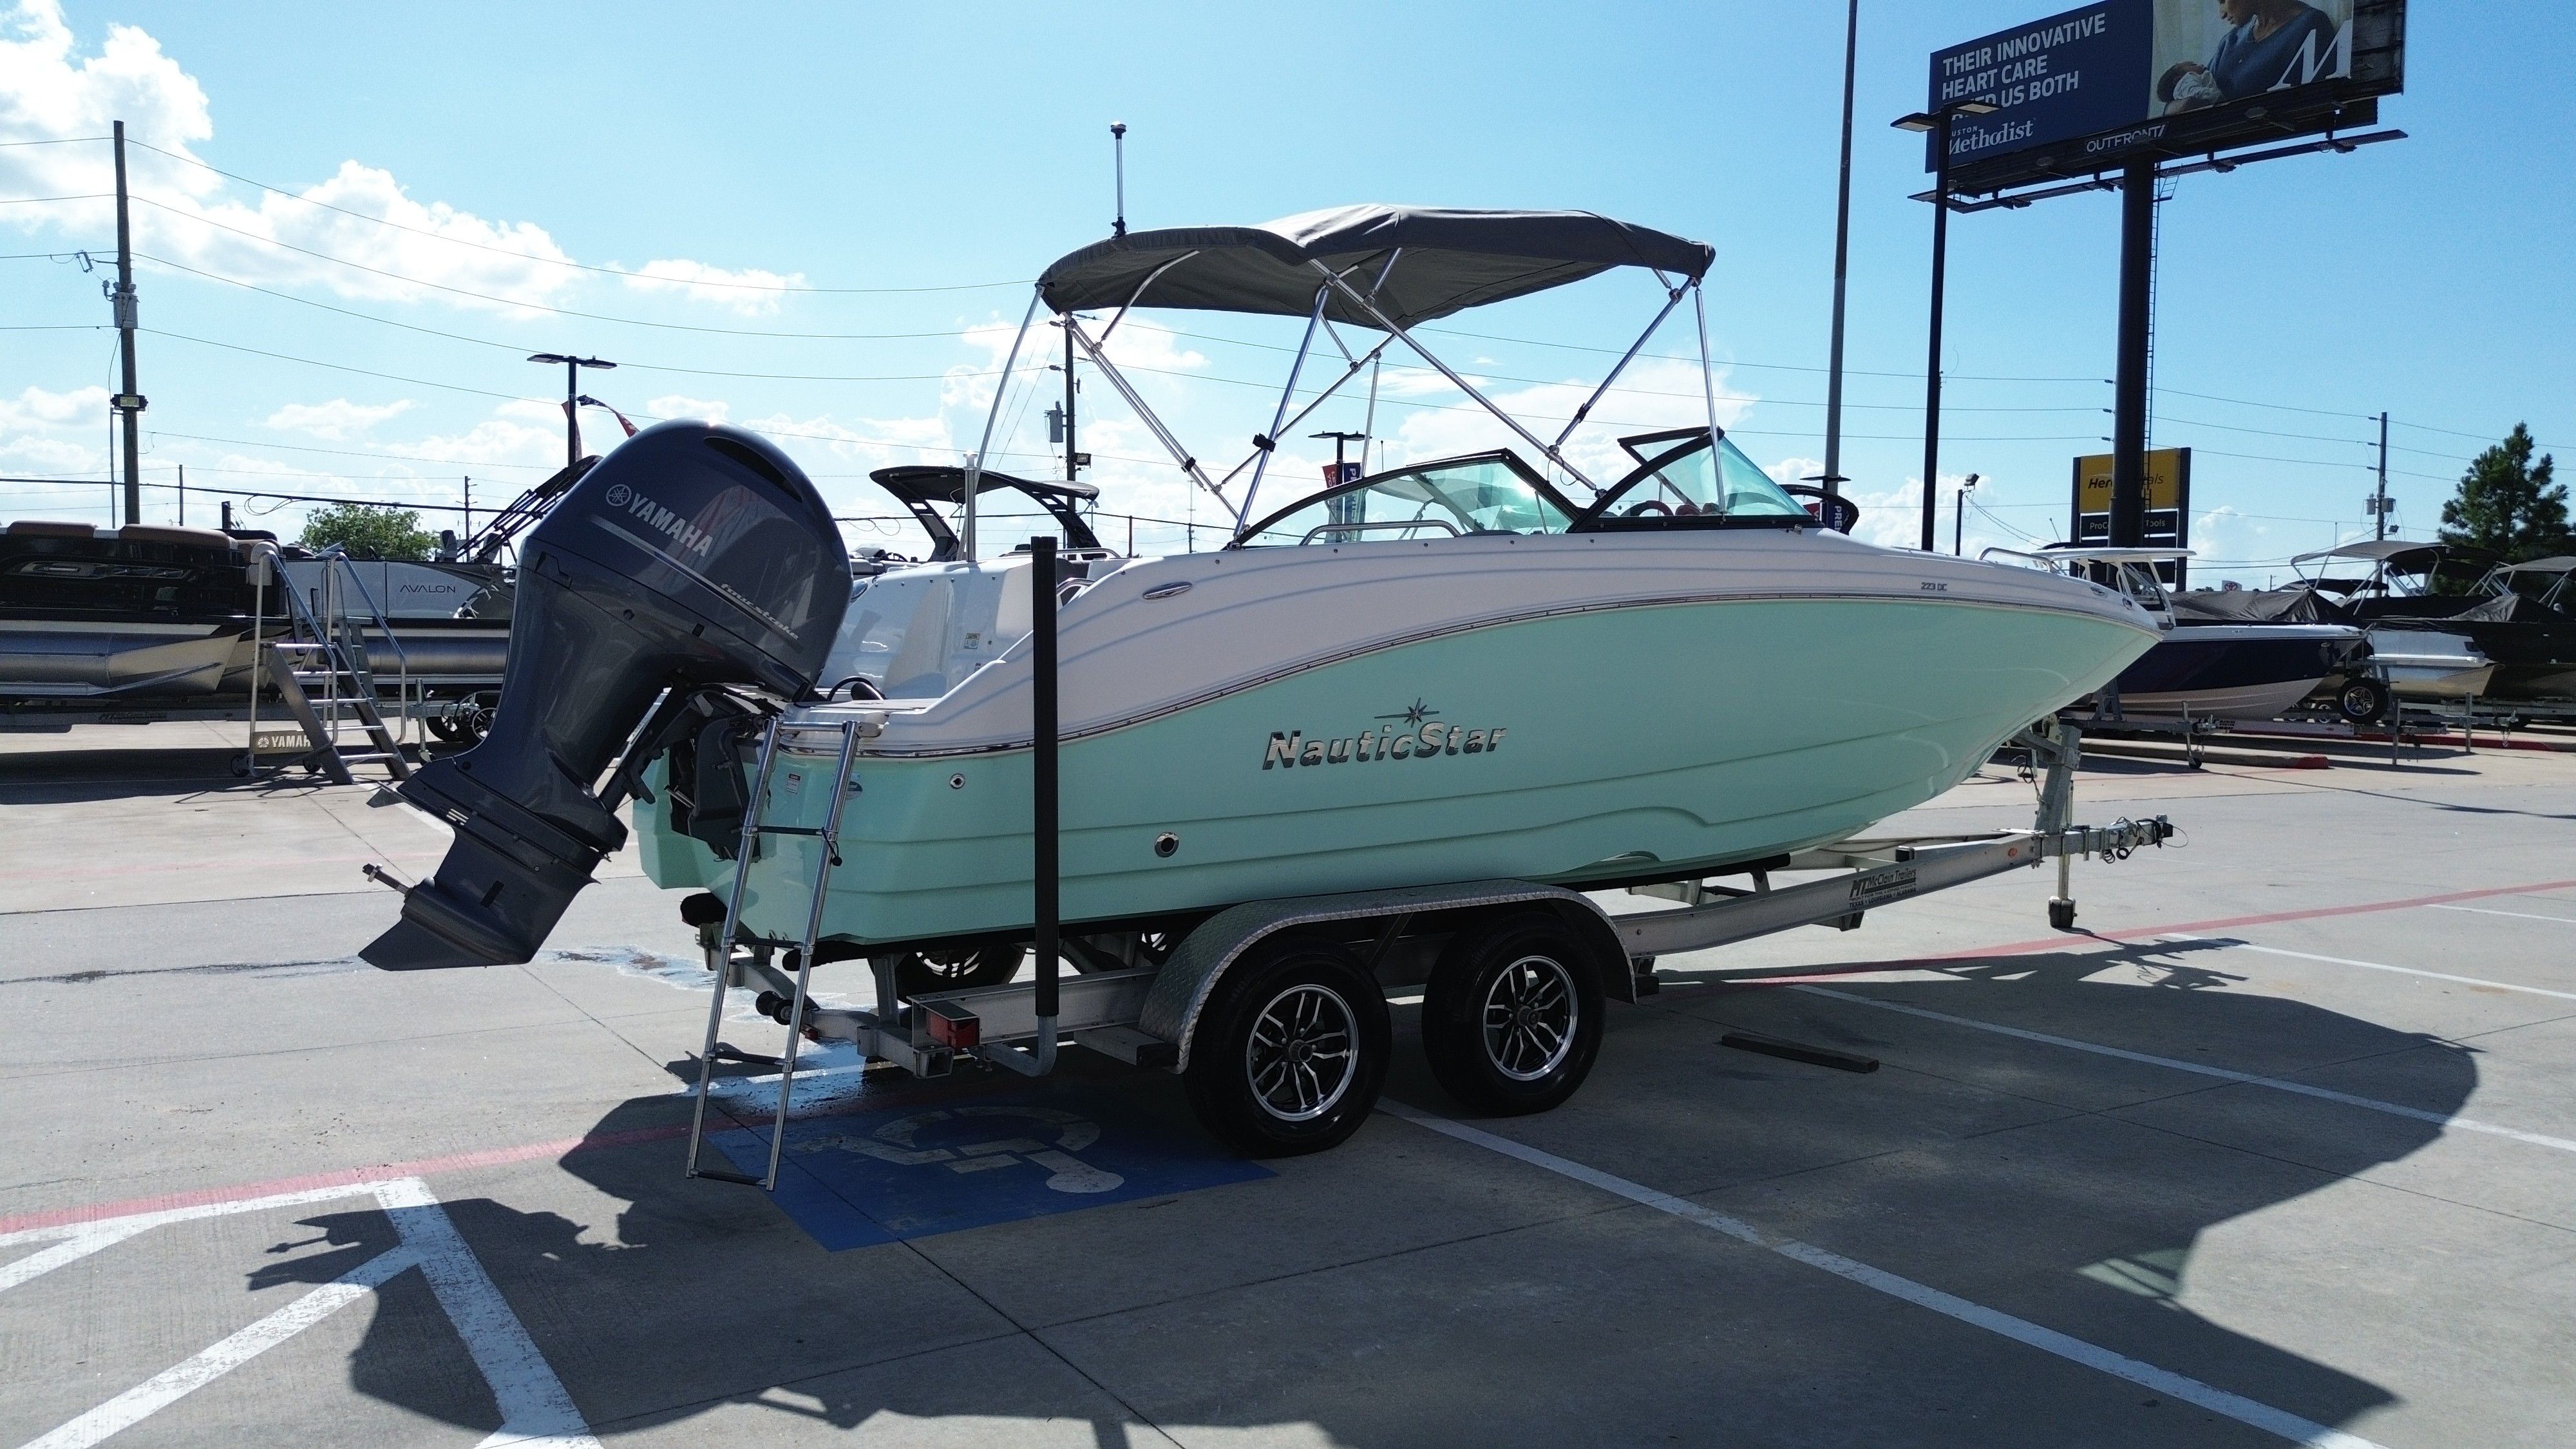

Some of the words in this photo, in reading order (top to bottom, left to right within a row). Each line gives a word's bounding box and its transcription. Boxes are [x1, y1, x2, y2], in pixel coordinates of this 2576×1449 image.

[1943, 47, 1992, 77] THEIR
[1997, 13, 2105, 62] INNOVATIVE
[1942, 68, 1998, 100] HEART
[2002, 55, 2048, 84] CARE
[2001, 85, 2025, 108] US
[2029, 70, 2079, 101] BOTH
[628, 493, 714, 557] YAMAHA
[400, 585, 456, 593] AVALON
[1921, 582, 1936, 591] 223
[1937, 583, 1947, 591] DC
[271, 735, 311, 748] YAMAH
[1262, 721, 1507, 770] NauticStar
